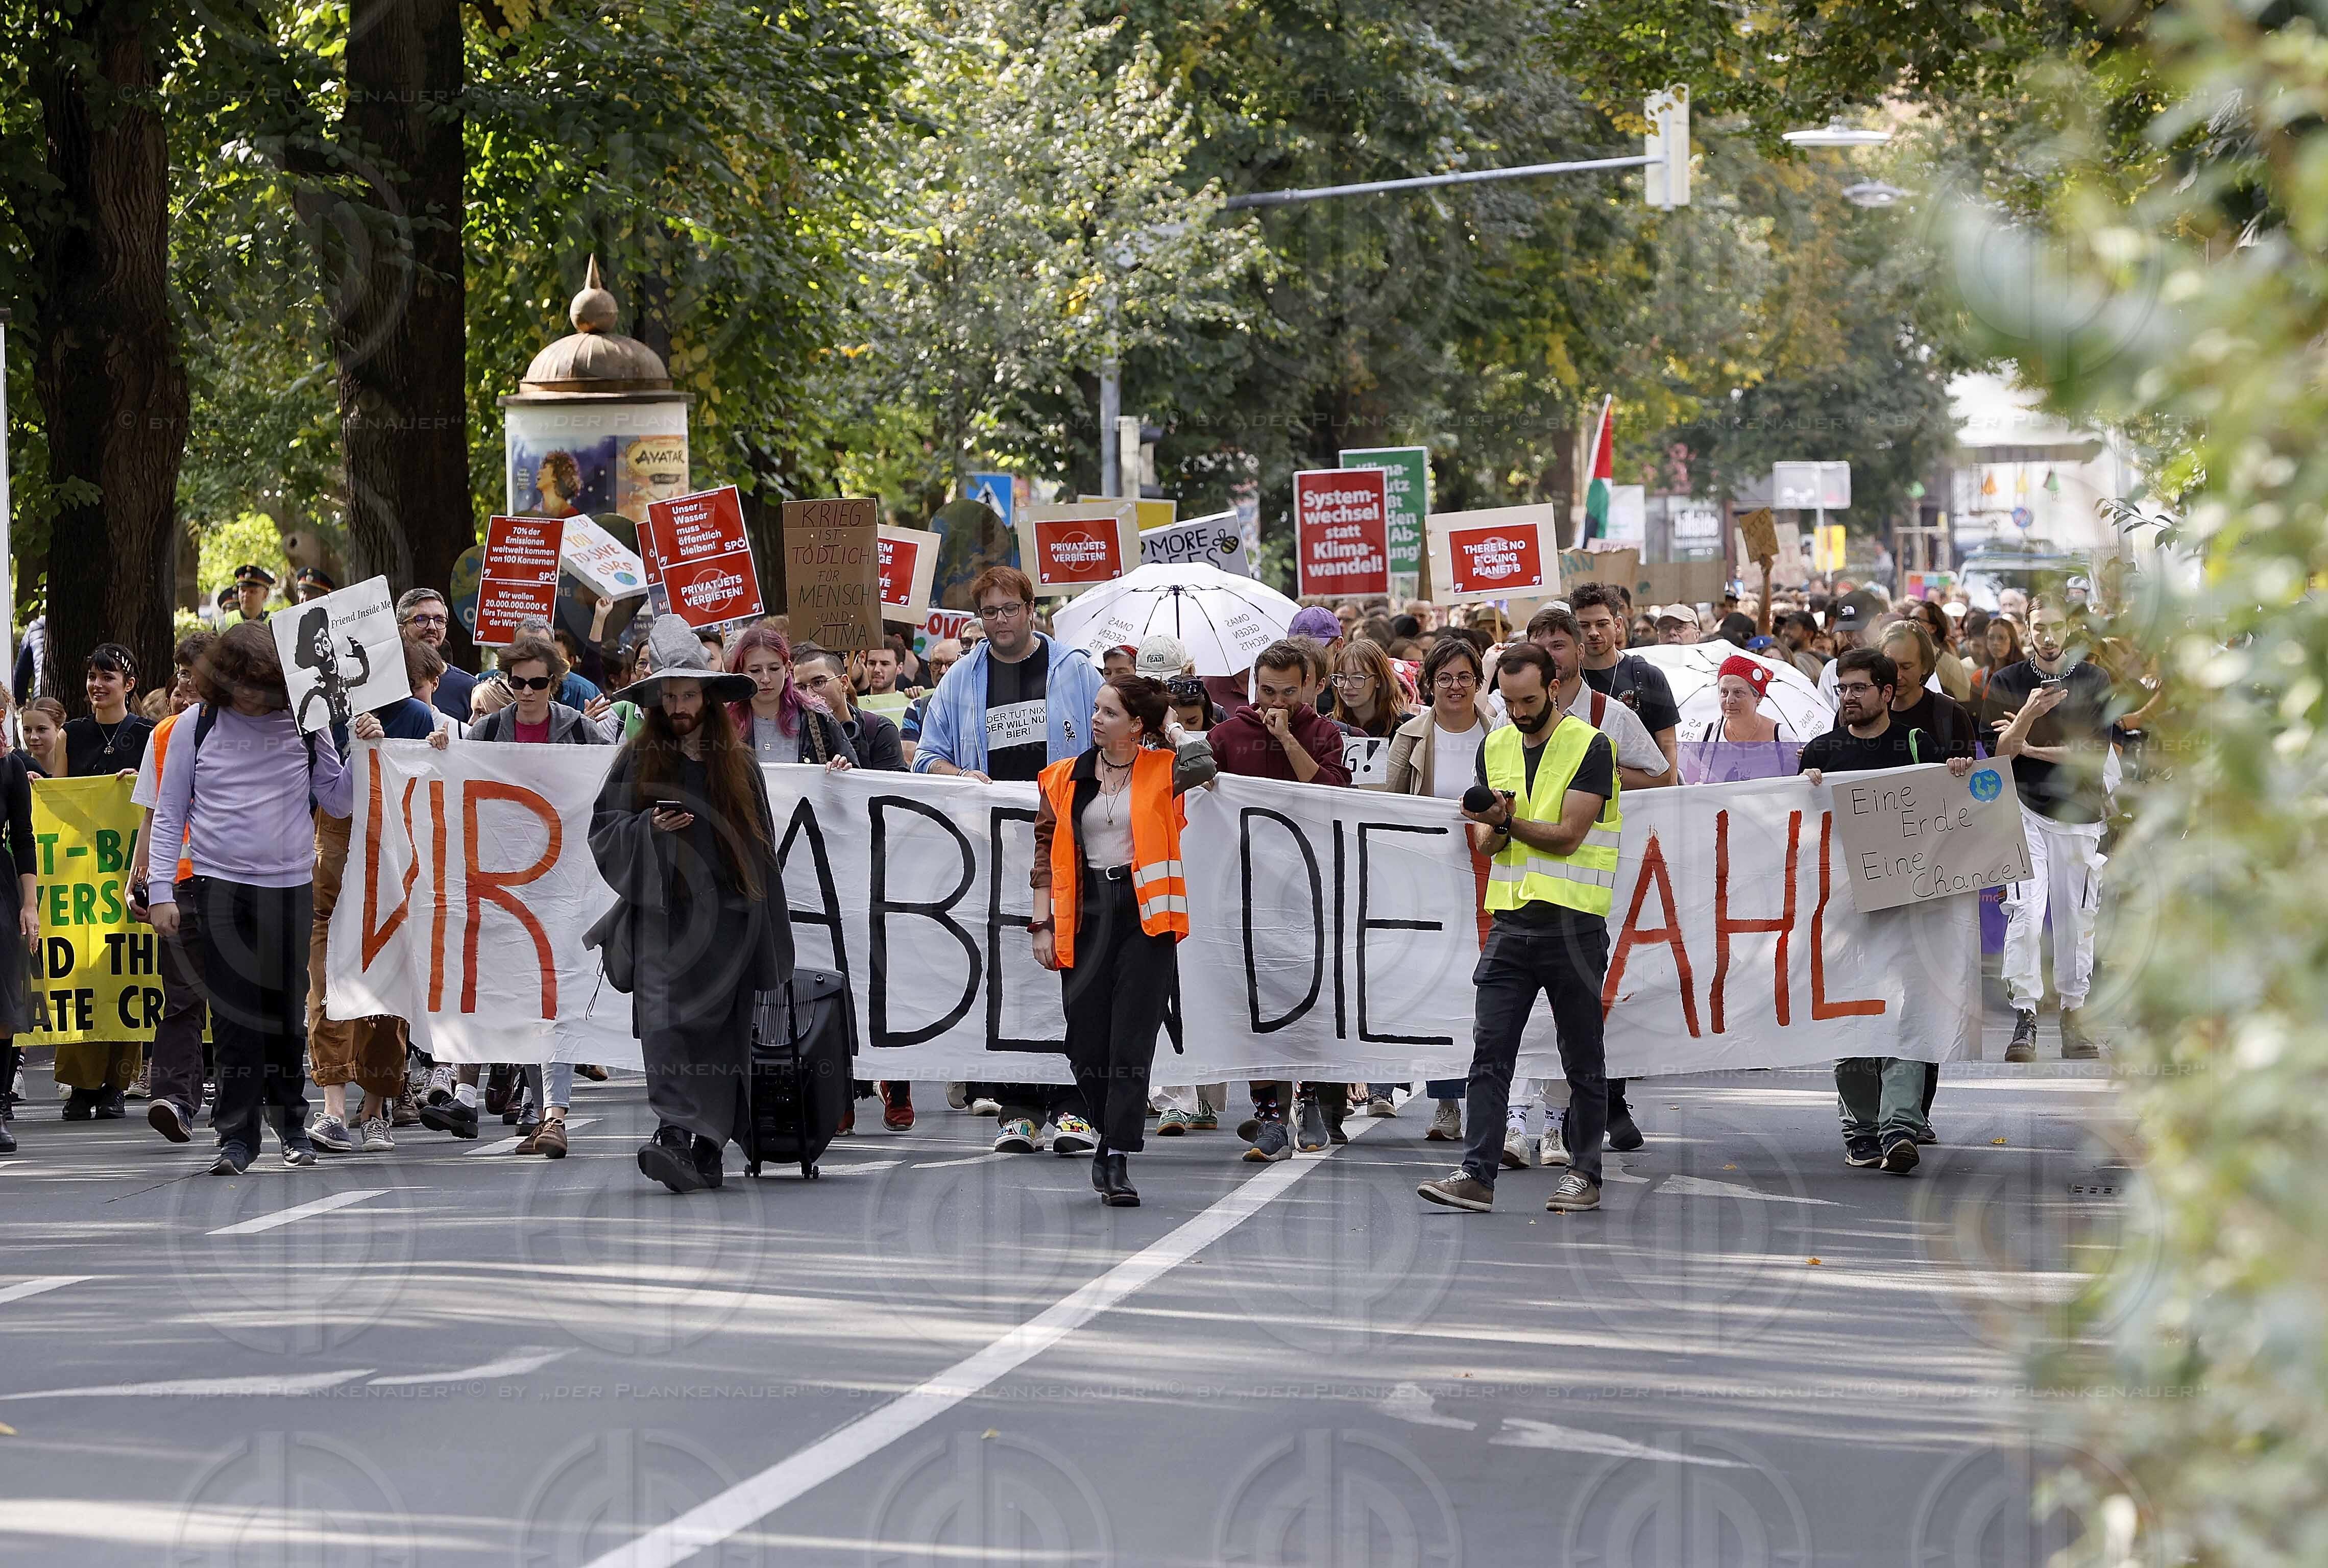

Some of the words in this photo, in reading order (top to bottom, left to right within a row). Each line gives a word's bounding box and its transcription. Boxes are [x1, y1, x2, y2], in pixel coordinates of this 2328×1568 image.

[635, 450, 685, 464] AVATAR
[1302, 489, 1379, 510] System-
[672, 503, 698, 514] Unser
[802, 502, 863, 527] KRIEG
[1303, 503, 1379, 525] wechsel
[673, 512, 708, 525] Wasser
[513, 527, 527, 535] 70%
[528, 527, 541, 535] der
[676, 525, 700, 535] muss
[678, 529, 722, 546] öffentlich
[818, 529, 842, 541] IST
[1325, 524, 1362, 540] statt
[1391, 527, 1420, 542] Ab-
[505, 536, 545, 546] Emissionen
[564, 533, 594, 548] YOU
[724, 536, 746, 551] SPÖ
[1050, 541, 1106, 552] PRIVATJETS
[1149, 528, 1208, 557] MORE
[1463, 542, 1496, 555] THERE
[1498, 541, 1508, 551] IS
[1509, 540, 1526, 550] NO
[493, 546, 524, 554] weltweit
[525, 547, 554, 556] kommen
[569, 552, 590, 563] TO
[588, 543, 620, 560] SAVE
[680, 541, 717, 556] bleiben!
[792, 543, 871, 565] TÖDLICH
[1313, 541, 1376, 560] Klima-
[517, 556, 554, 566] Konzernen
[1052, 552, 1106, 562] VERBIETEN!
[597, 560, 633, 575] OURS
[1307, 555, 1384, 577] wandel!
[1472, 564, 1513, 576] PLANET
[1513, 563, 1521, 573] B
[539, 571, 556, 581] SPÖ
[817, 569, 840, 582] FÜR
[681, 574, 743, 596] PRIVATJETS
[498, 591, 511, 599] Wir
[684, 586, 744, 607] VERBIETEN!
[798, 584, 871, 608] MENSCH
[880, 590, 888, 598] E
[486, 600, 540, 610] 20.000.000.000
[331, 611, 356, 629] Friend
[357, 604, 380, 619] Inside
[380, 600, 391, 610] Me
[482, 608, 495, 617] fürs
[497, 609, 548, 620] Transformieren
[820, 610, 849, 623] UND
[502, 619, 517, 627] Wirt
[809, 624, 868, 647] KLIMA
[986, 713, 1007, 723] DER
[1009, 709, 1027, 719] TUT
[1029, 706, 1046, 715] NIX
[1006, 718, 1029, 729] WILL
[1851, 786, 1916, 815] Eine
[1901, 798, 1973, 838] Erde
[1861, 851, 1926, 881] Eine
[1912, 843, 2028, 898] Chance!
[777, 795, 1184, 1055] ABE
[1240, 807, 1453, 1046] DIE
[1465, 809, 1886, 1039] AHL
[105, 933, 162, 975] TH
